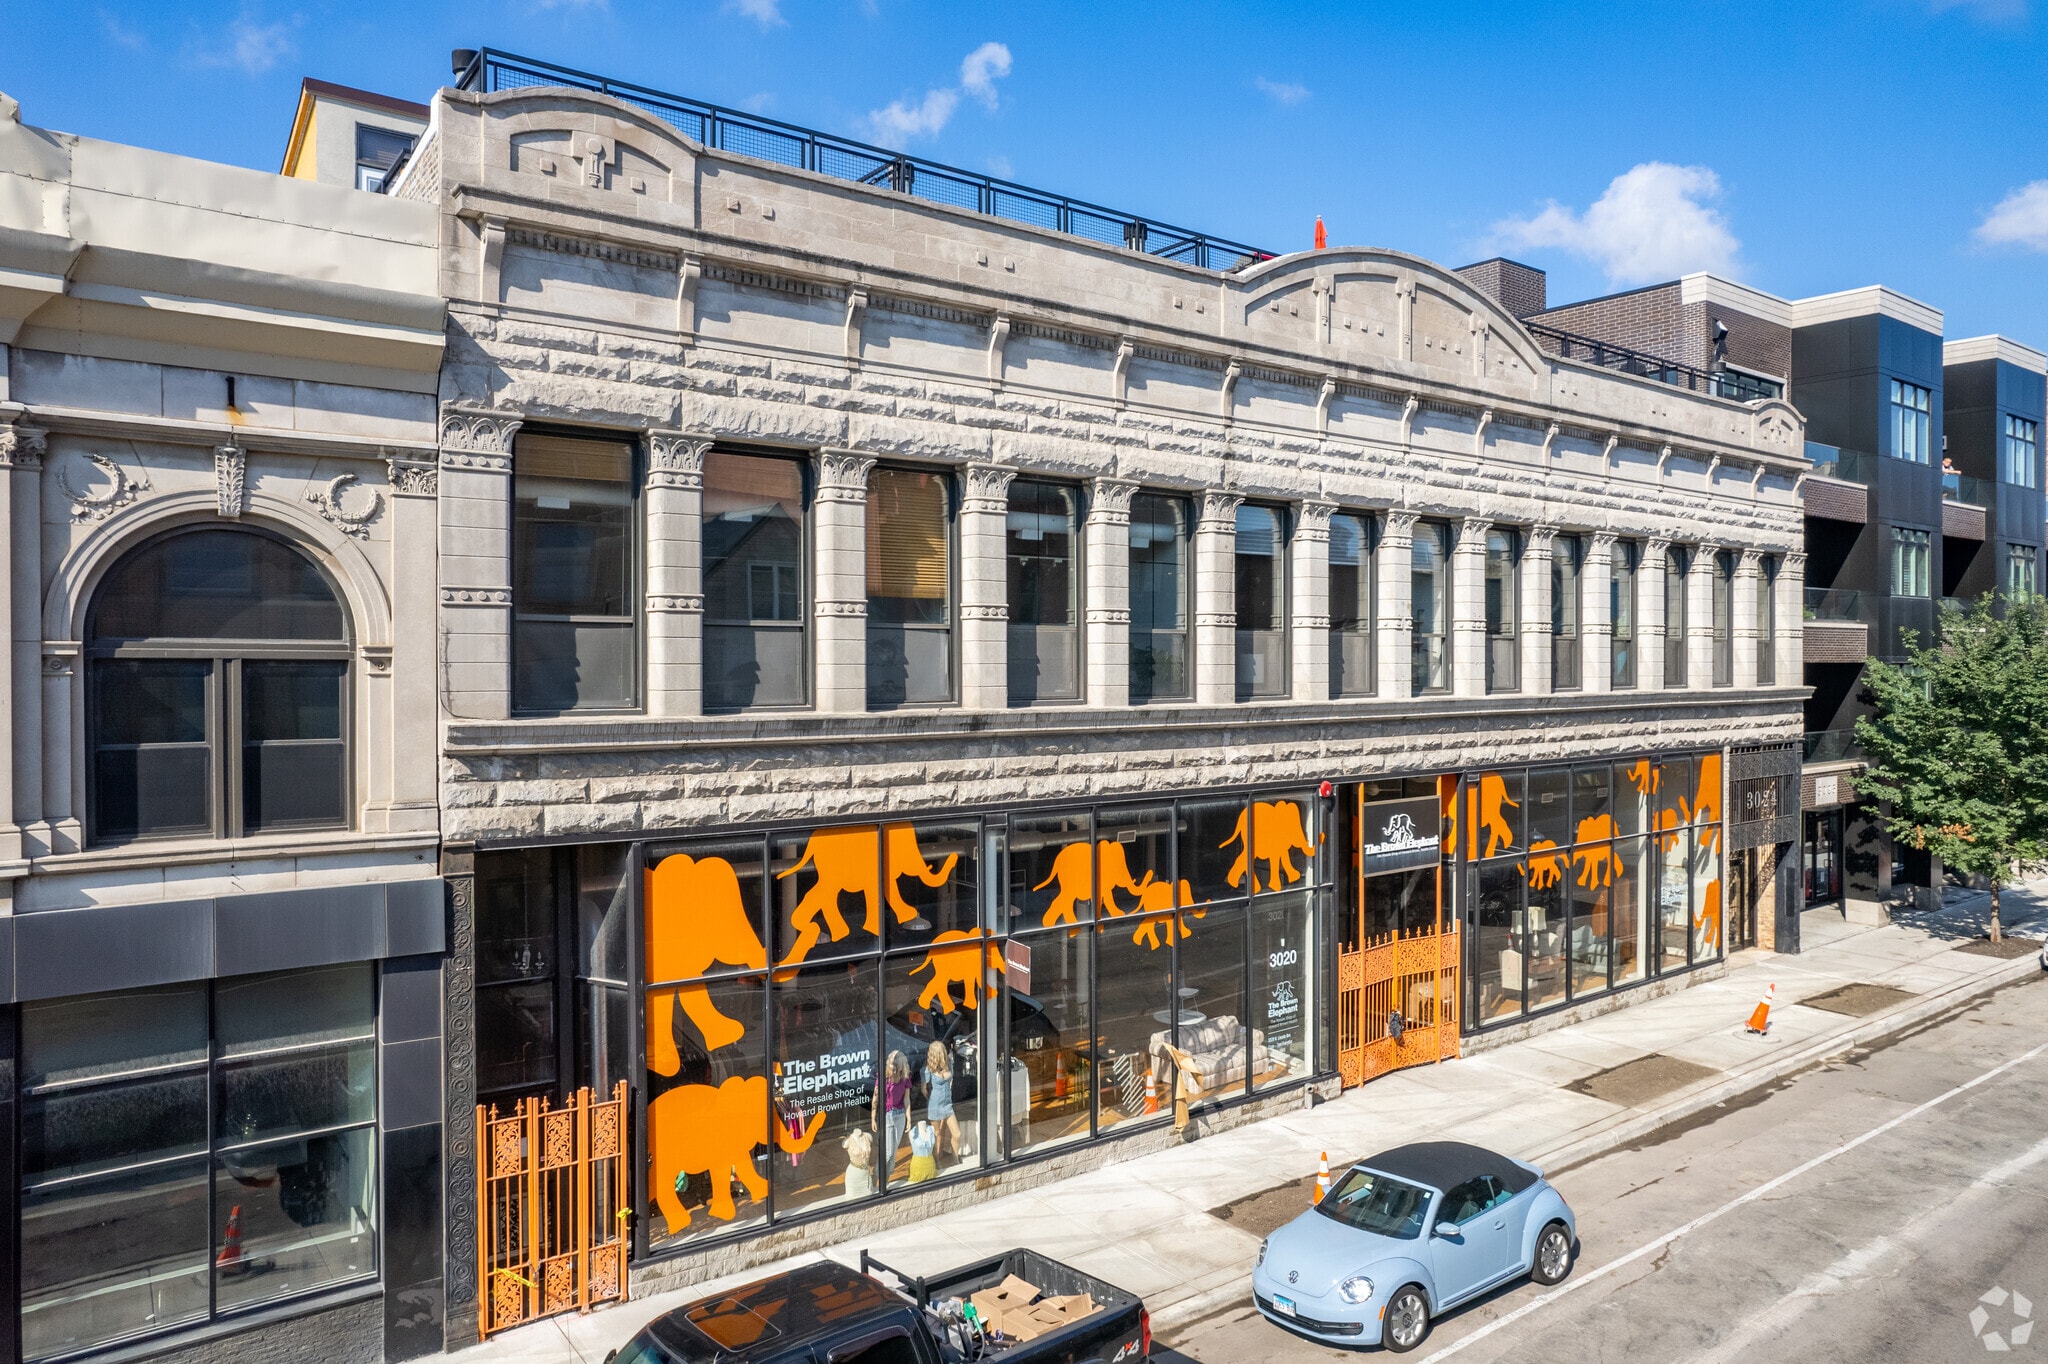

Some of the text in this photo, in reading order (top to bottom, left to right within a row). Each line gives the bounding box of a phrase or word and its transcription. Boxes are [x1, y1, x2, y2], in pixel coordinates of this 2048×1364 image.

[1364, 844, 1381, 855] The
[1407, 835, 1439, 850] Elephant
[1269, 949, 1297, 967] 3020
[1268, 998, 1298, 1010] The Brown
[1268, 1004, 1298, 1018] Elephant
[783, 1049, 870, 1076] The Brown
[783, 1062, 871, 1095] Elephant
[790, 1084, 865, 1109] The Resale Shop of
[784, 1095, 870, 1121] Howard Brown Health
